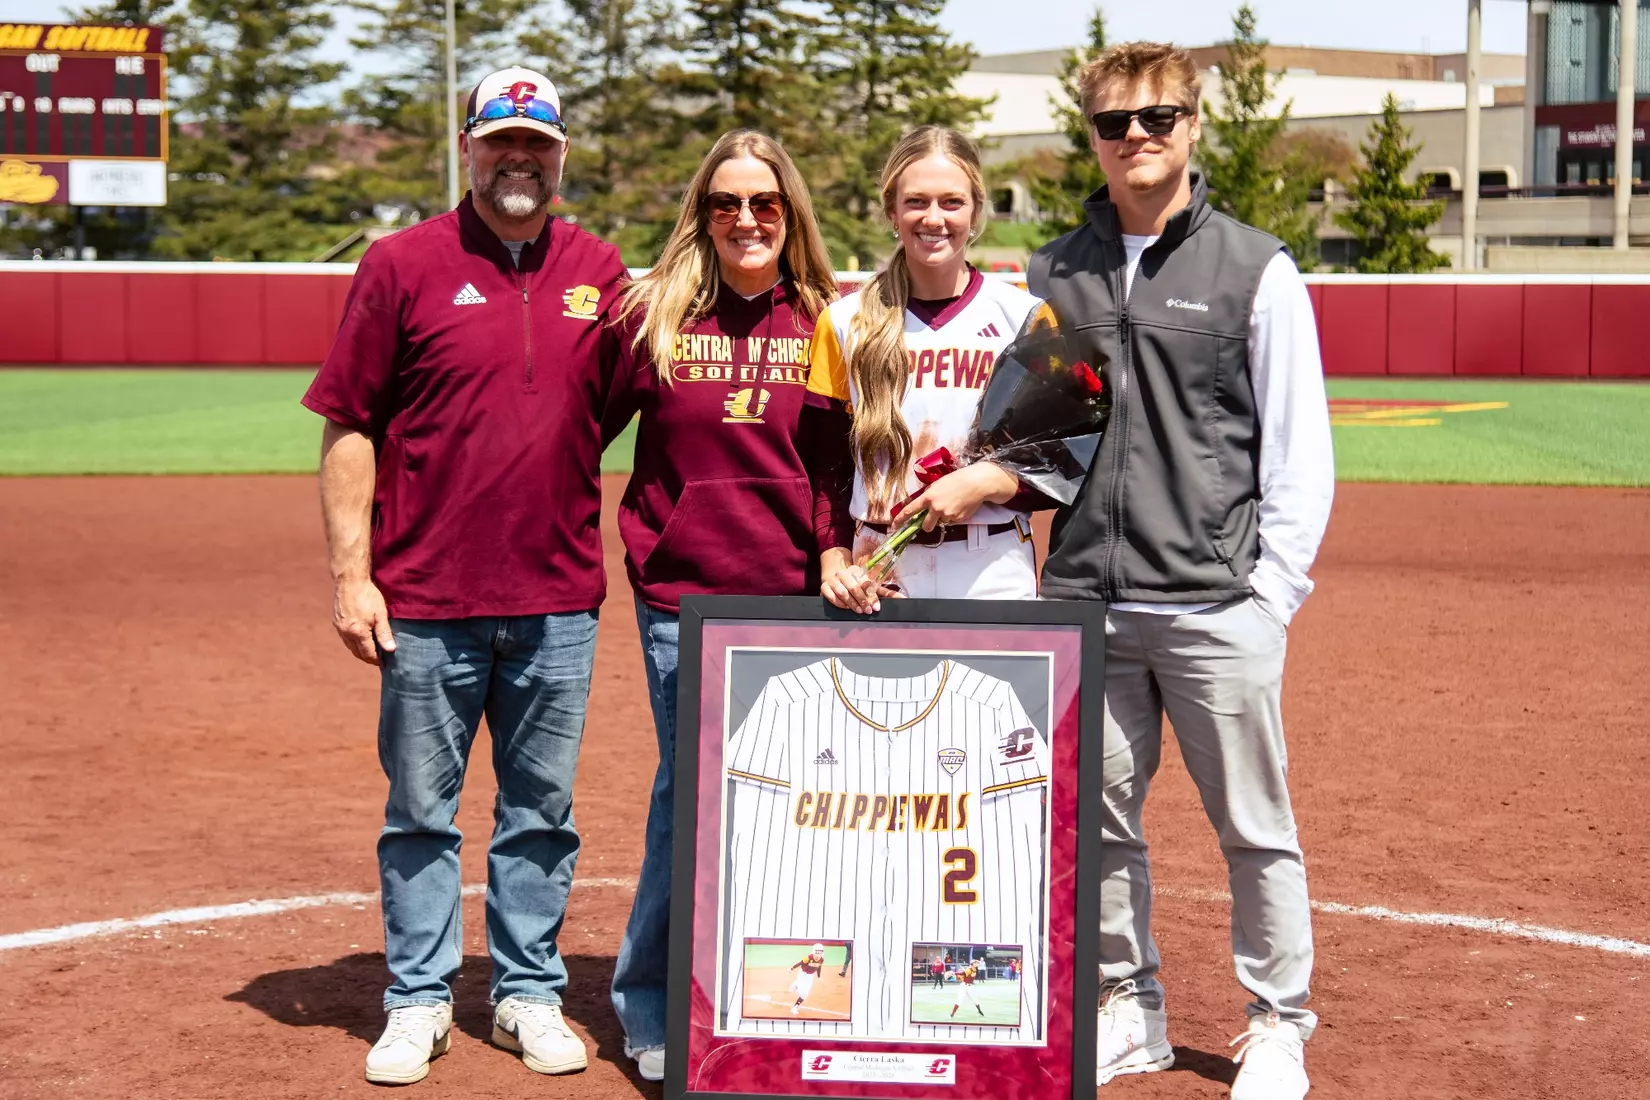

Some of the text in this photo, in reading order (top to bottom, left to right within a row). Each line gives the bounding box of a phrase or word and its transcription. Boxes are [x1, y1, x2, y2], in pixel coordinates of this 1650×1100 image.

[453, 296, 487, 305] adidas
[1174, 299, 1209, 312] Columbia
[747, 336, 811, 366] MCHIGA
[812, 757, 839, 765] adidas
[939, 756, 965, 764] MAC
[794, 791, 971, 833] CHIPPEWAS
[942, 846, 978, 905] 2
[853, 1055, 905, 1064] Cierra Laska
